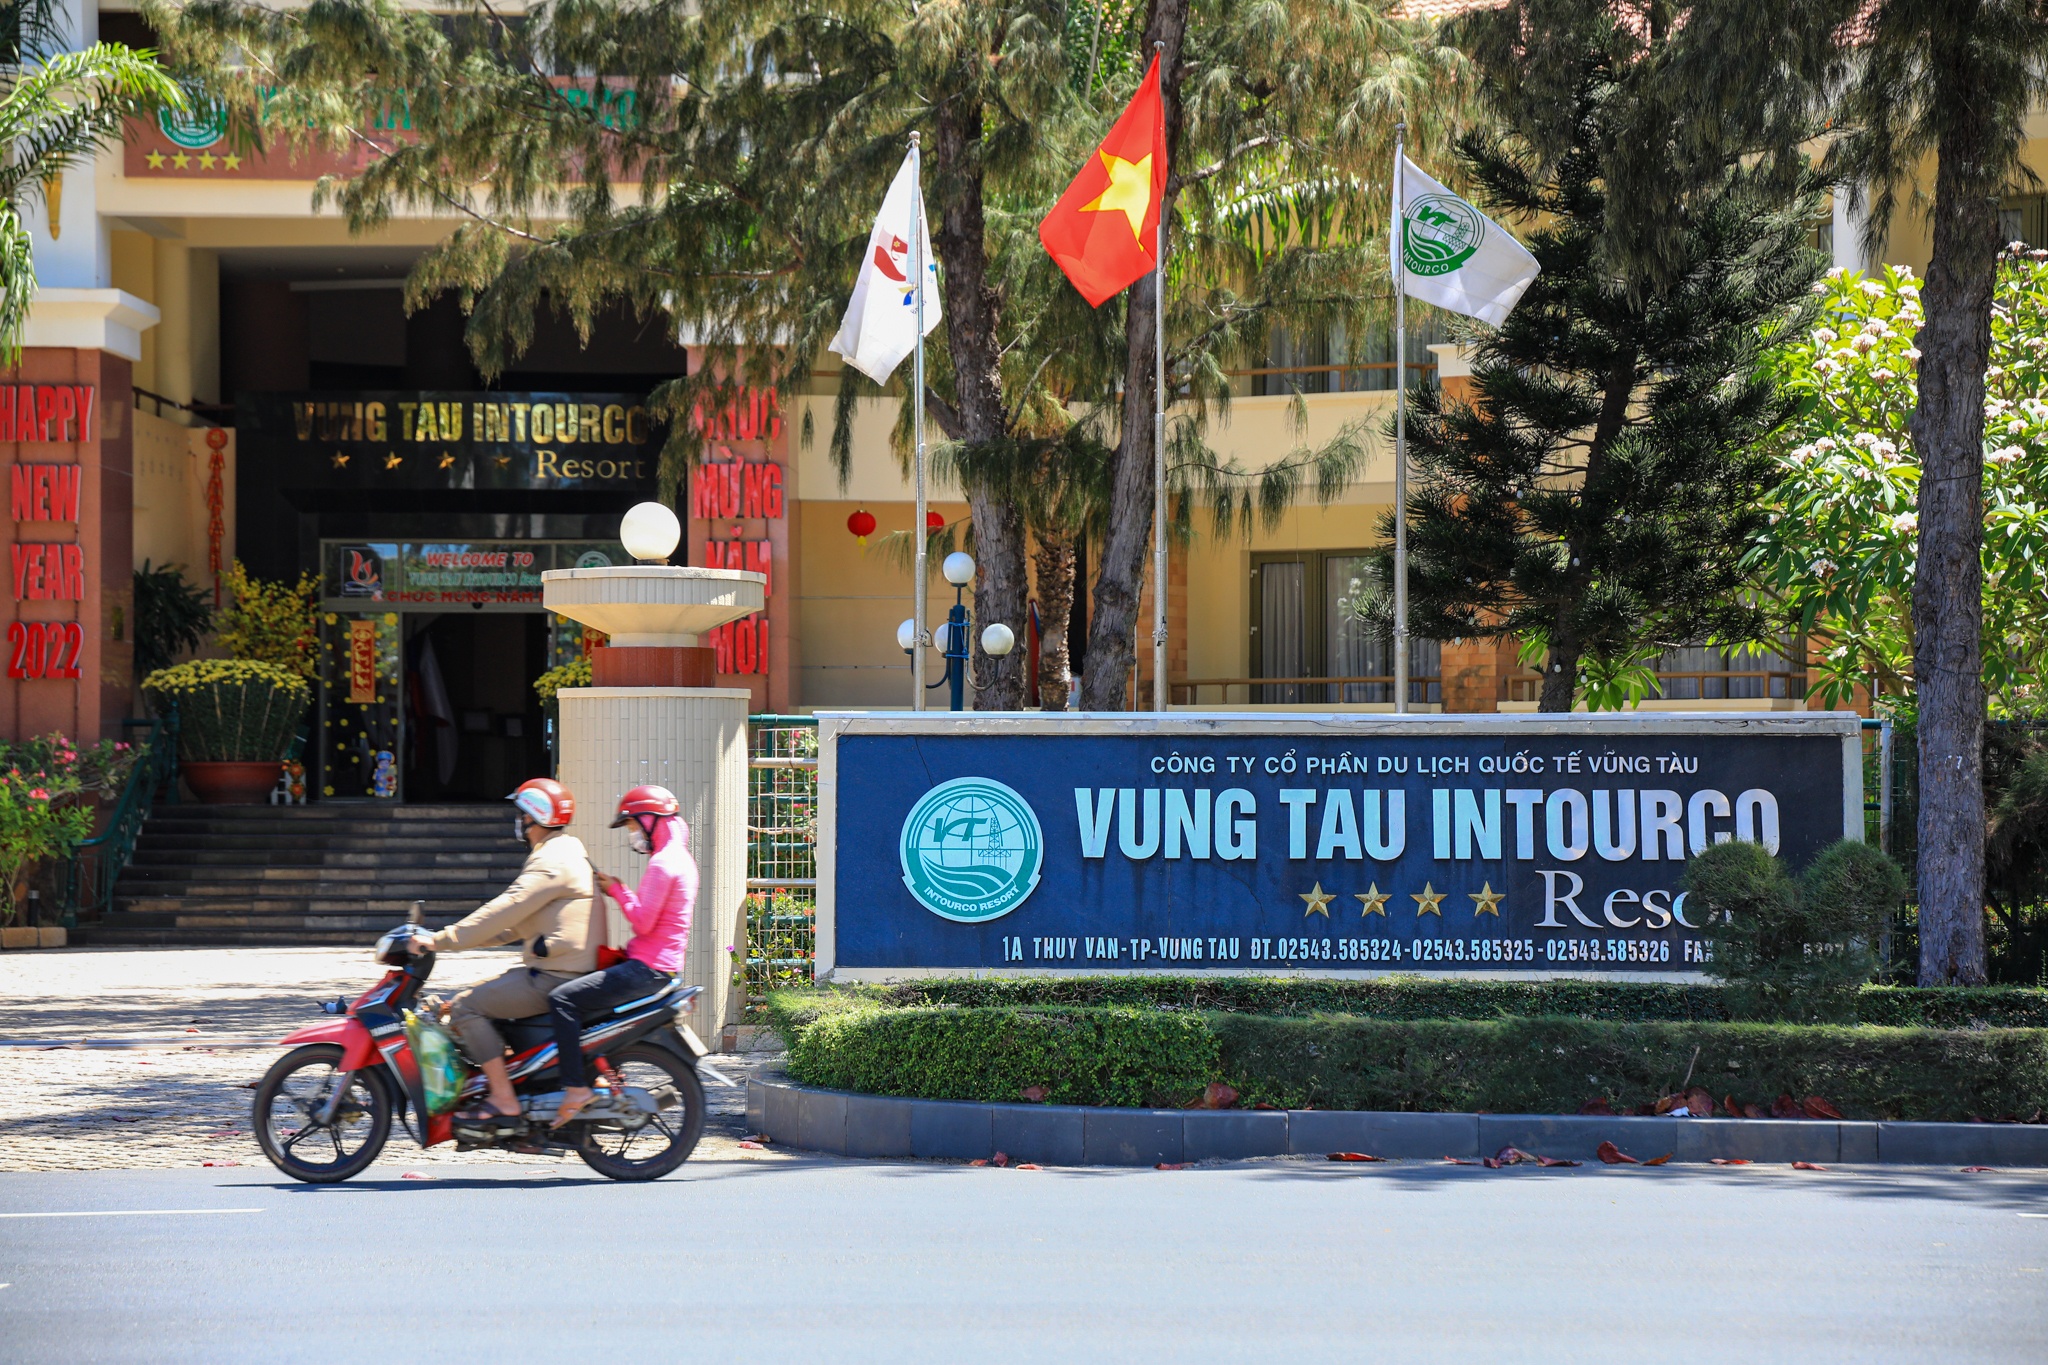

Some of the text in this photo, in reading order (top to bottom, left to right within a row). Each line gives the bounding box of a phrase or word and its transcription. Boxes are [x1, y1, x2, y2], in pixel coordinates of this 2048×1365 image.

[0, 384, 94, 443] HAPPY
[293, 401, 648, 445] VUNG TAU INTOURCO
[535, 449, 646, 480] Resort
[693, 446, 783, 519] MỪNG
[11, 463, 81, 523] NEW
[10, 542, 84, 600] YEAR
[426, 552, 534, 567] WELCOME TO
[7, 621, 83, 679] 2022
[1150, 748, 1698, 777] CÔNG TY CỔ PHẦN DU LỊCH QUỐC TẾ VŨNG TÀU
[1074, 788, 1781, 860] VUNG TAU INTOURCO
[923, 886, 1020, 912] INTOURCO RESORT
[1002, 936, 1023, 961] 1A
[1033, 937, 1078, 960] THUY
[1208, 937, 1239, 960] TAU
